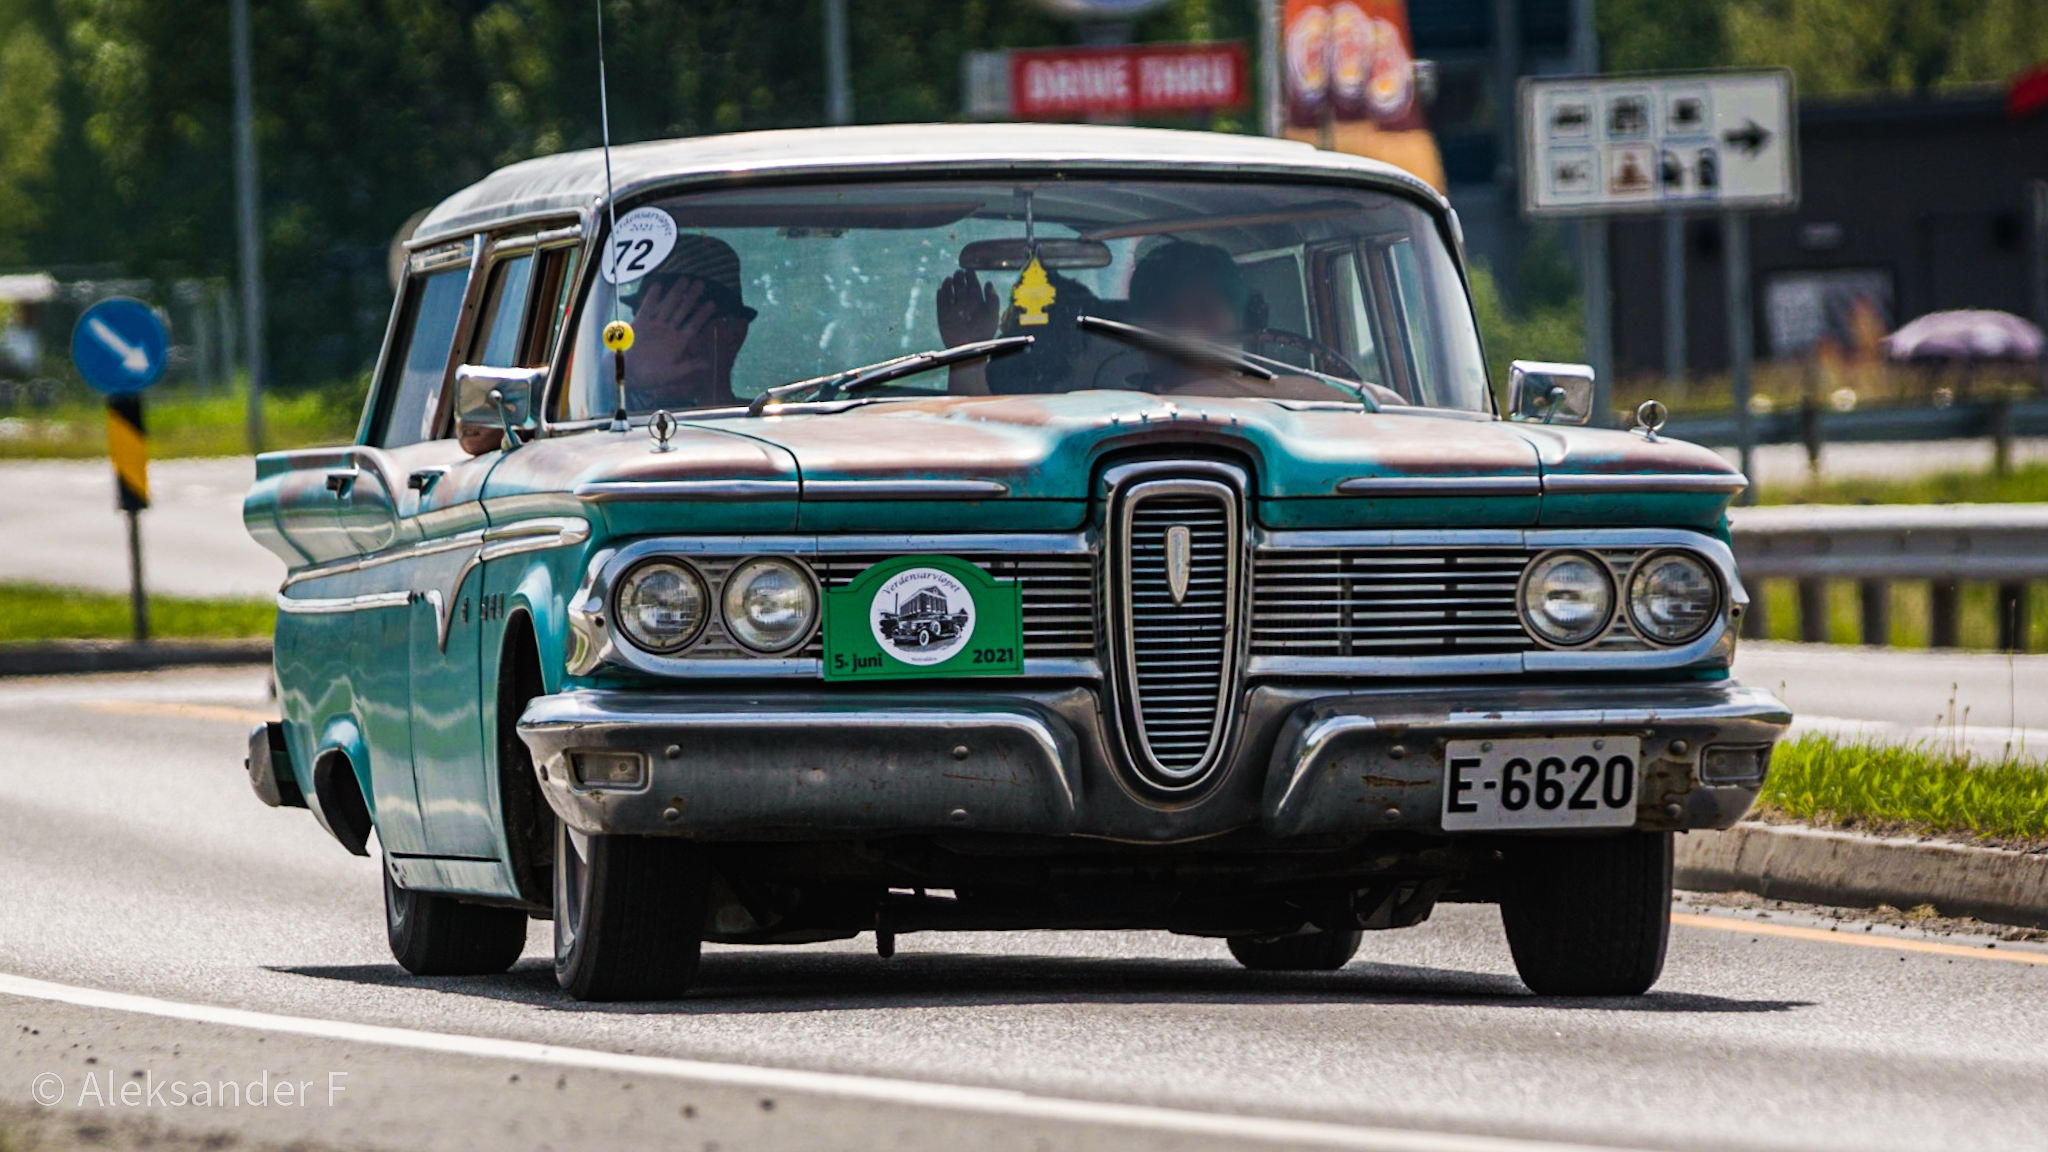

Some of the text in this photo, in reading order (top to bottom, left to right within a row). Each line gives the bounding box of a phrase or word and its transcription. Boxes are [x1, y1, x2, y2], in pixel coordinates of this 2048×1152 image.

[1024, 53, 1235, 100] DRIVE THRU
[610, 238, 654, 275] 72
[881, 571, 962, 596] Verdensarvløpet
[851, 652, 883, 673] juni
[972, 648, 1014, 664] 2021
[1447, 754, 1635, 814] E-6620
